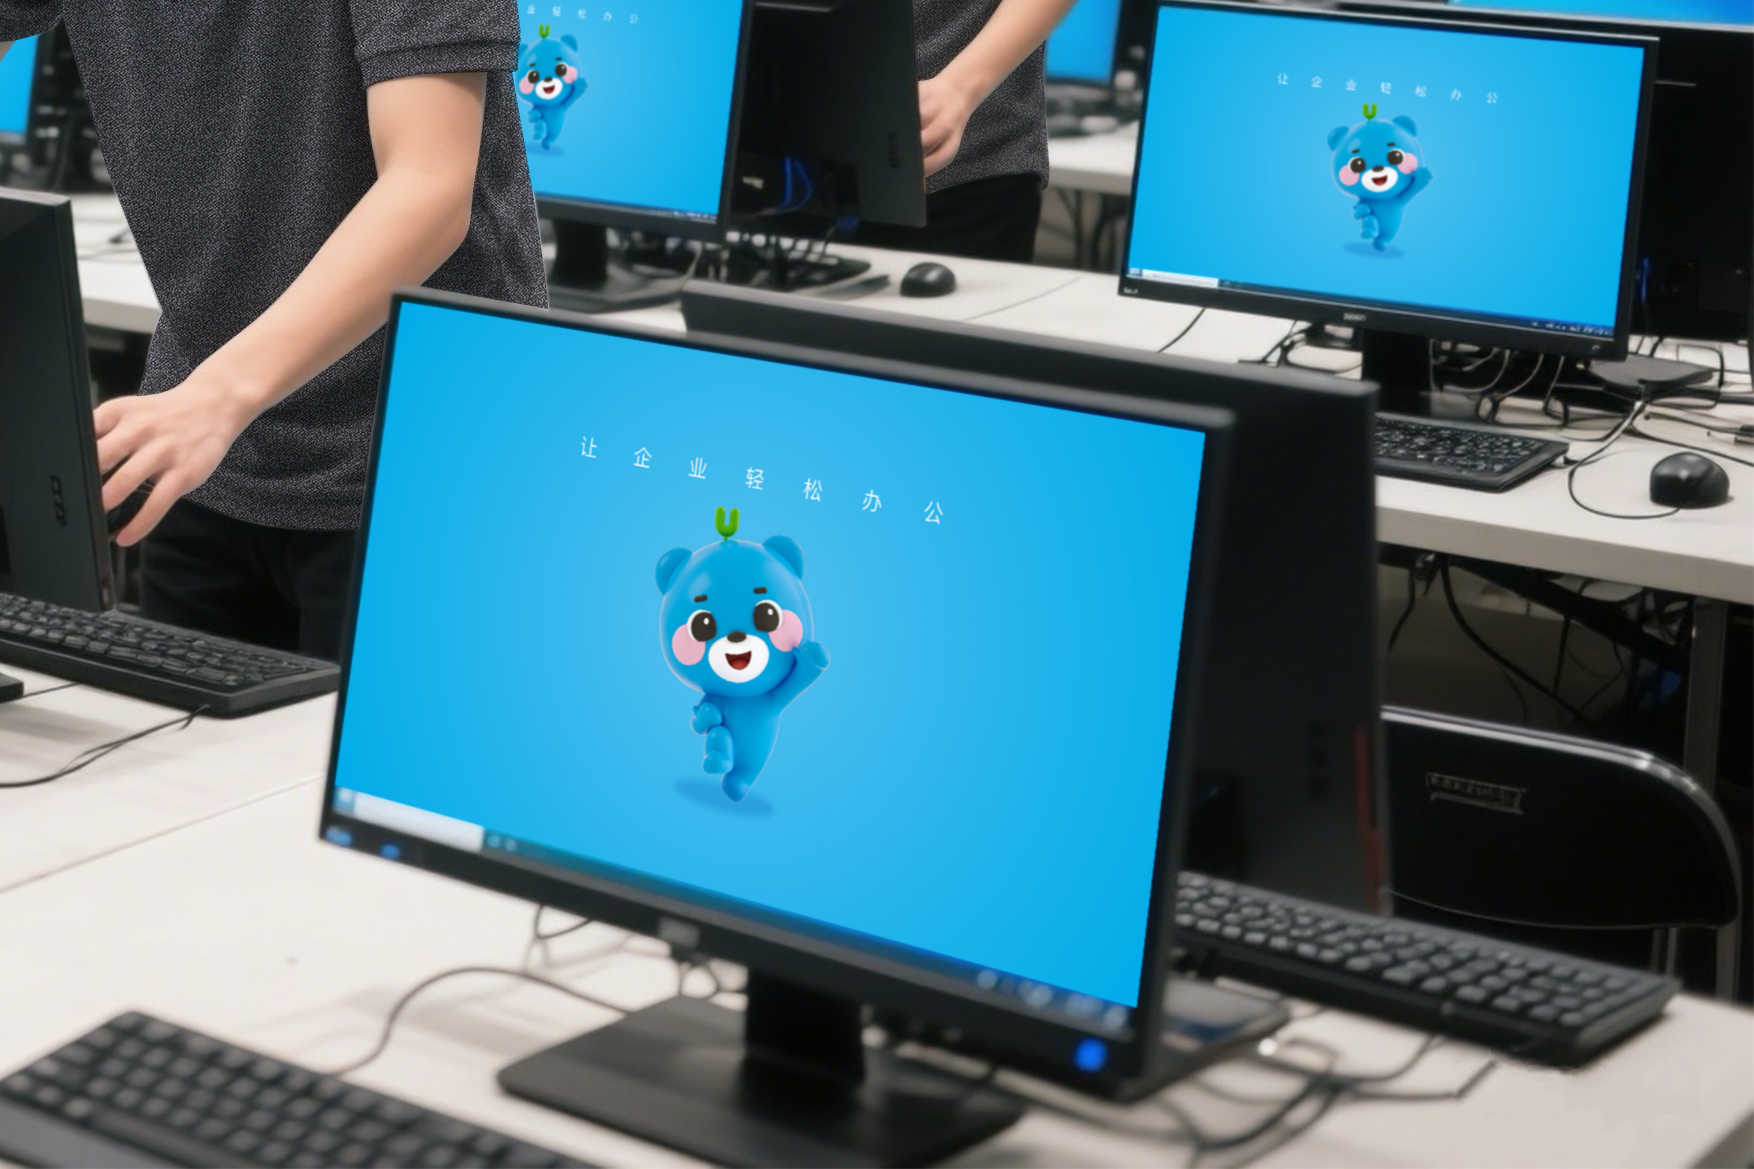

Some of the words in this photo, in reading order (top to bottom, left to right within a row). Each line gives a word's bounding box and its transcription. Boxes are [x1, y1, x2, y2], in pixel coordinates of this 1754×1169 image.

[1277, 72, 1499, 104] 让企业轻松办公
[580, 435, 944, 526] 让企业轻松办公
